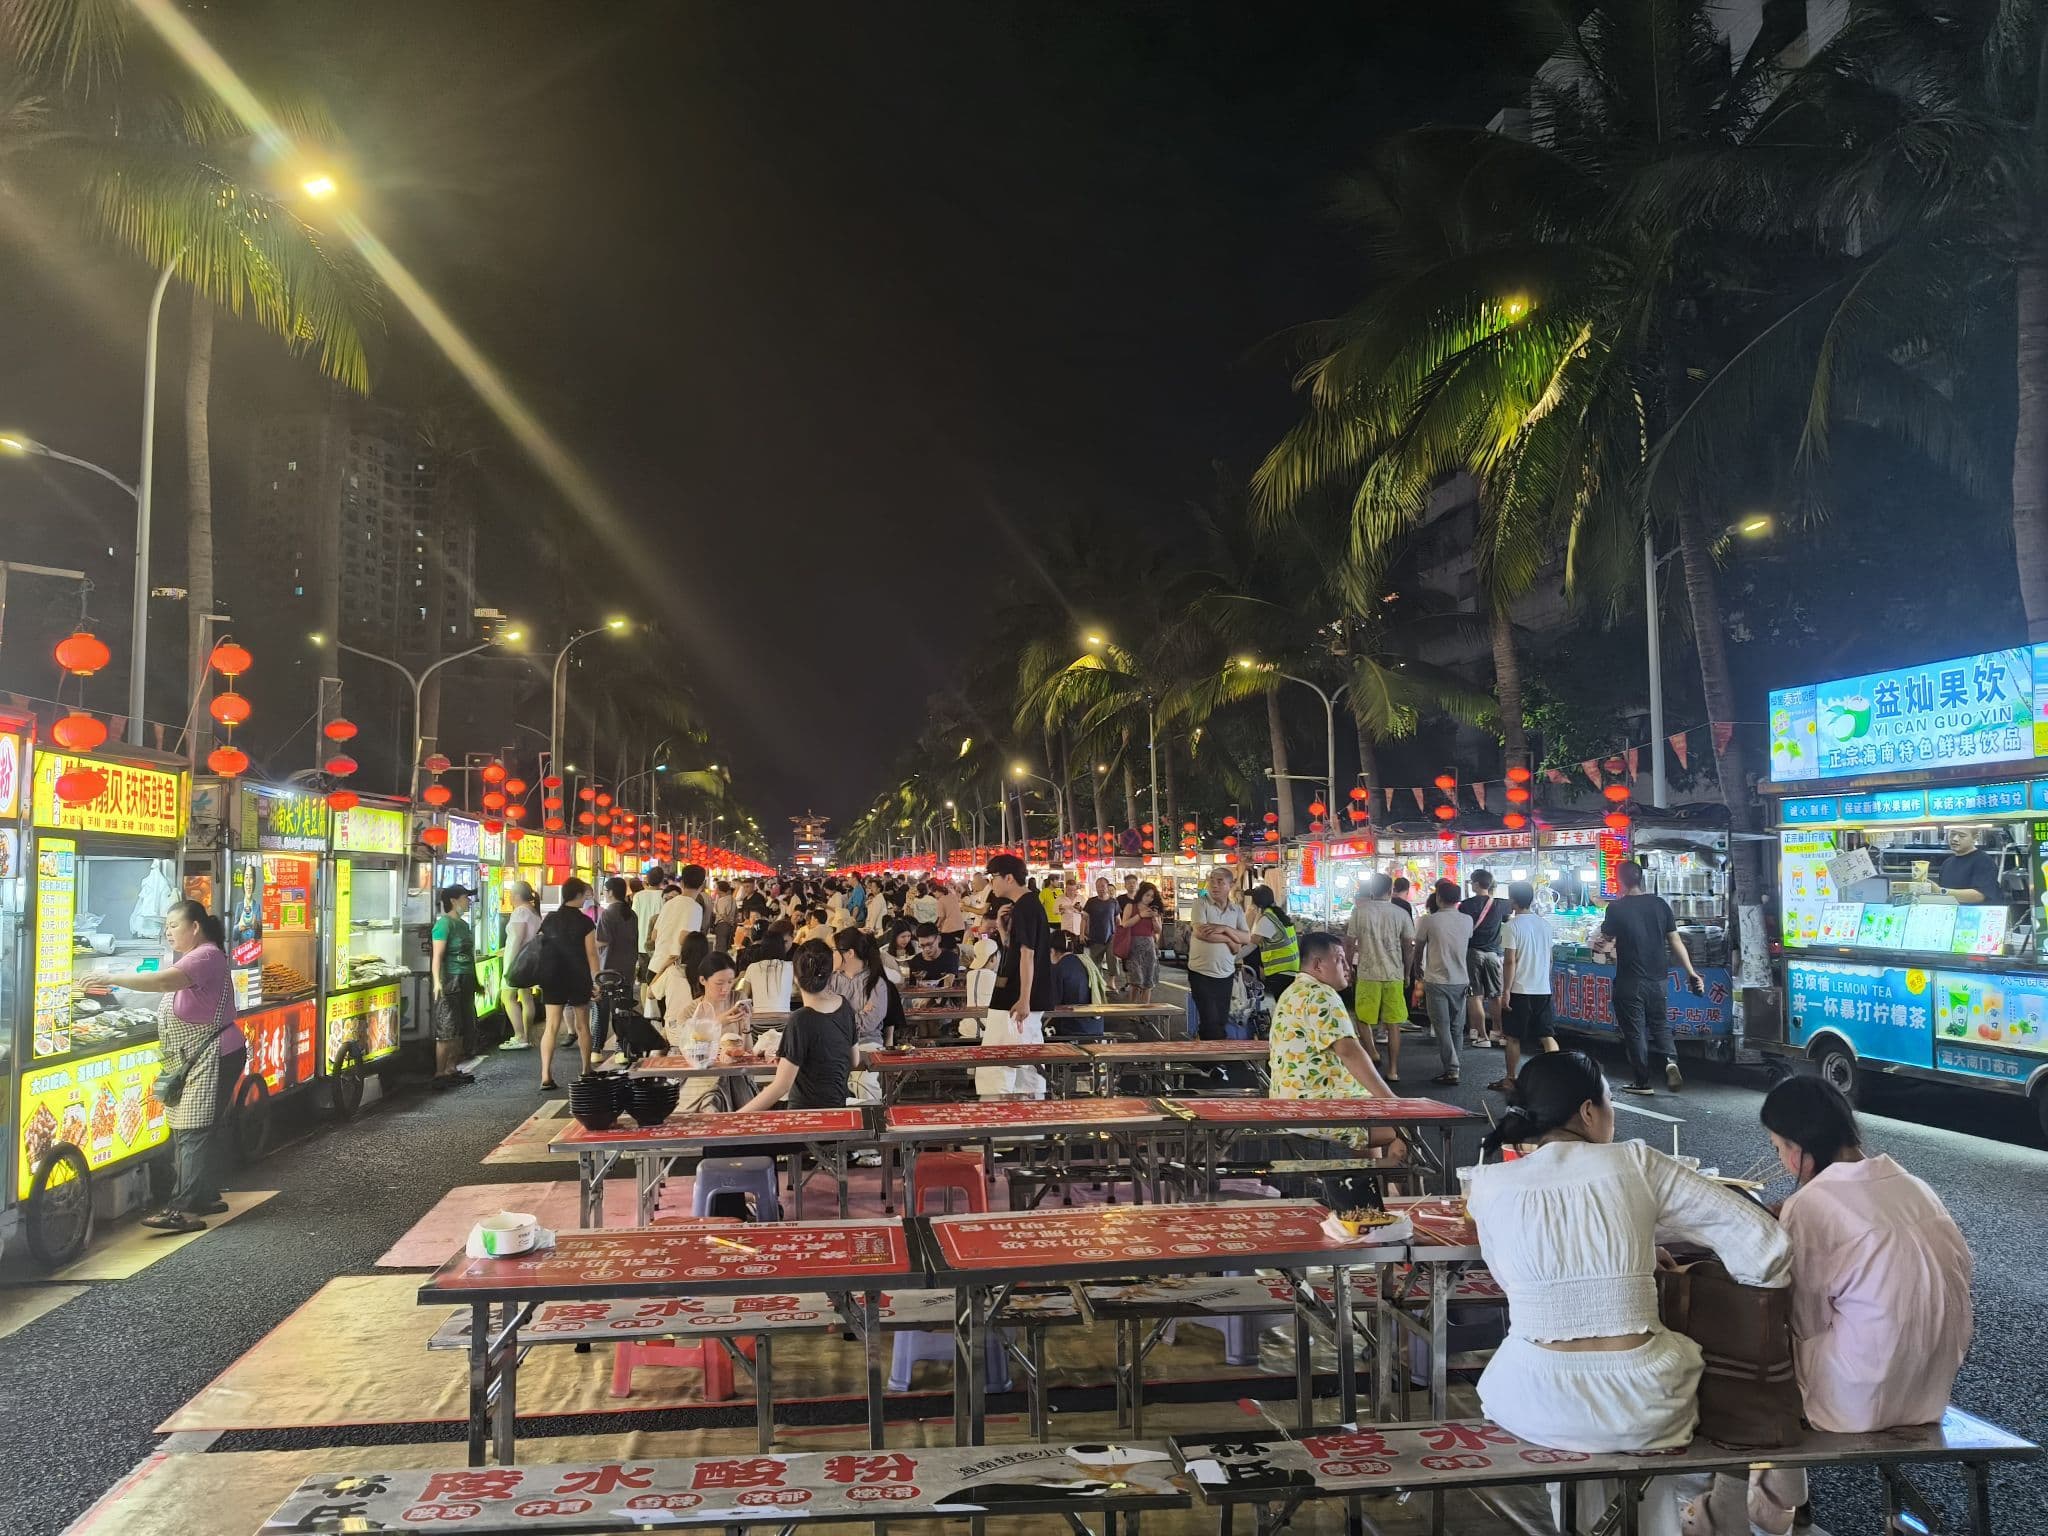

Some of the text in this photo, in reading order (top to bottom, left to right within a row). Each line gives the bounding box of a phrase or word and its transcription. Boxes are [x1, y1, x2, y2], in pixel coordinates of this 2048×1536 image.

[1874, 661, 2008, 719] 益灿果饮
[1874, 706, 2013, 737] YI CAN GUO YIN
[1828, 726, 2022, 769] 正宗海南特色鲜果饮品
[126, 770, 176, 820] 铁板鱿鱼
[1843, 797, 1922, 815] 保证新鲜水果制作
[1466, 834, 1532, 850] 手机电脑配件
[1832, 980, 1869, 997] LEMON
[1872, 984, 1893, 999] TEA
[1792, 992, 1927, 1030] 来一杯暴打柠檬茶
[418, 1453, 920, 1503] 陵水酸粉
[519, 1499, 588, 1515] 开胃
[743, 1489, 808, 1504] 浓郁
[851, 1486, 915, 1500] 嫩滑
